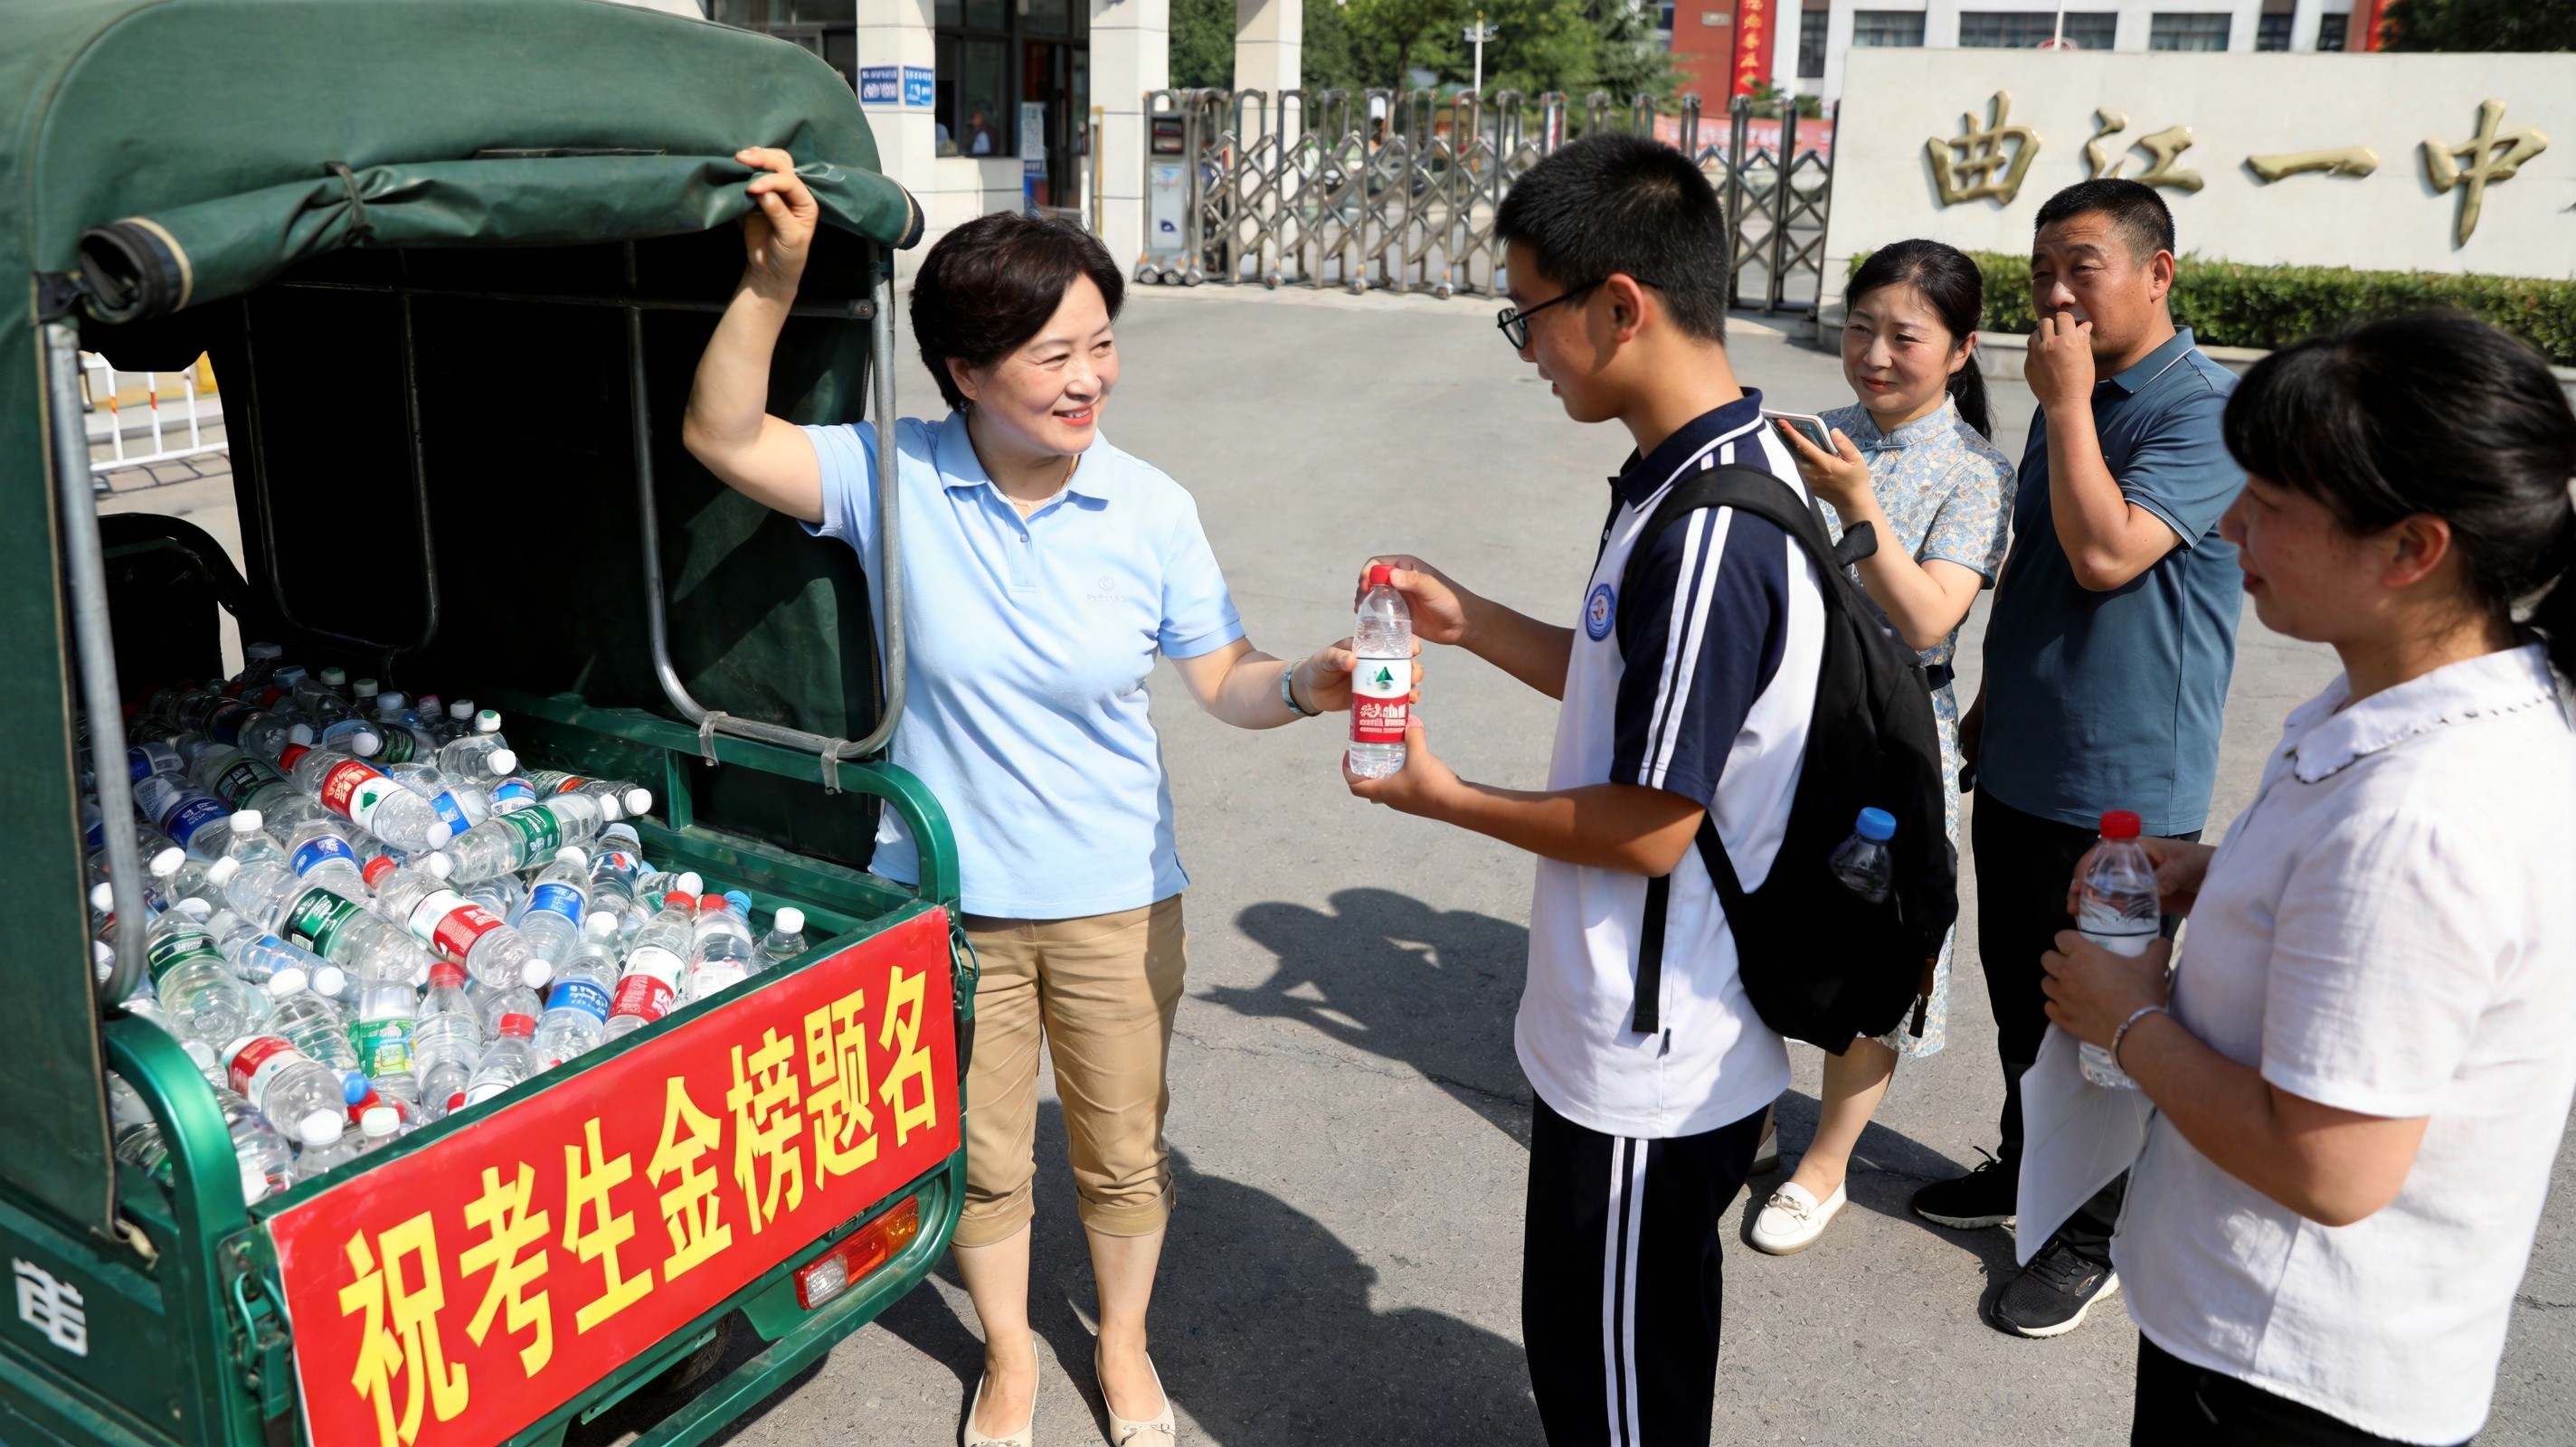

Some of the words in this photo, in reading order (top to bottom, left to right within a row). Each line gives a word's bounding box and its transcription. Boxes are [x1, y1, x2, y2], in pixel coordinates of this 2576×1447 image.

[1926, 90, 2549, 247] 曲江一中
[338, 965, 937, 1447] 祝考生金榜题名
